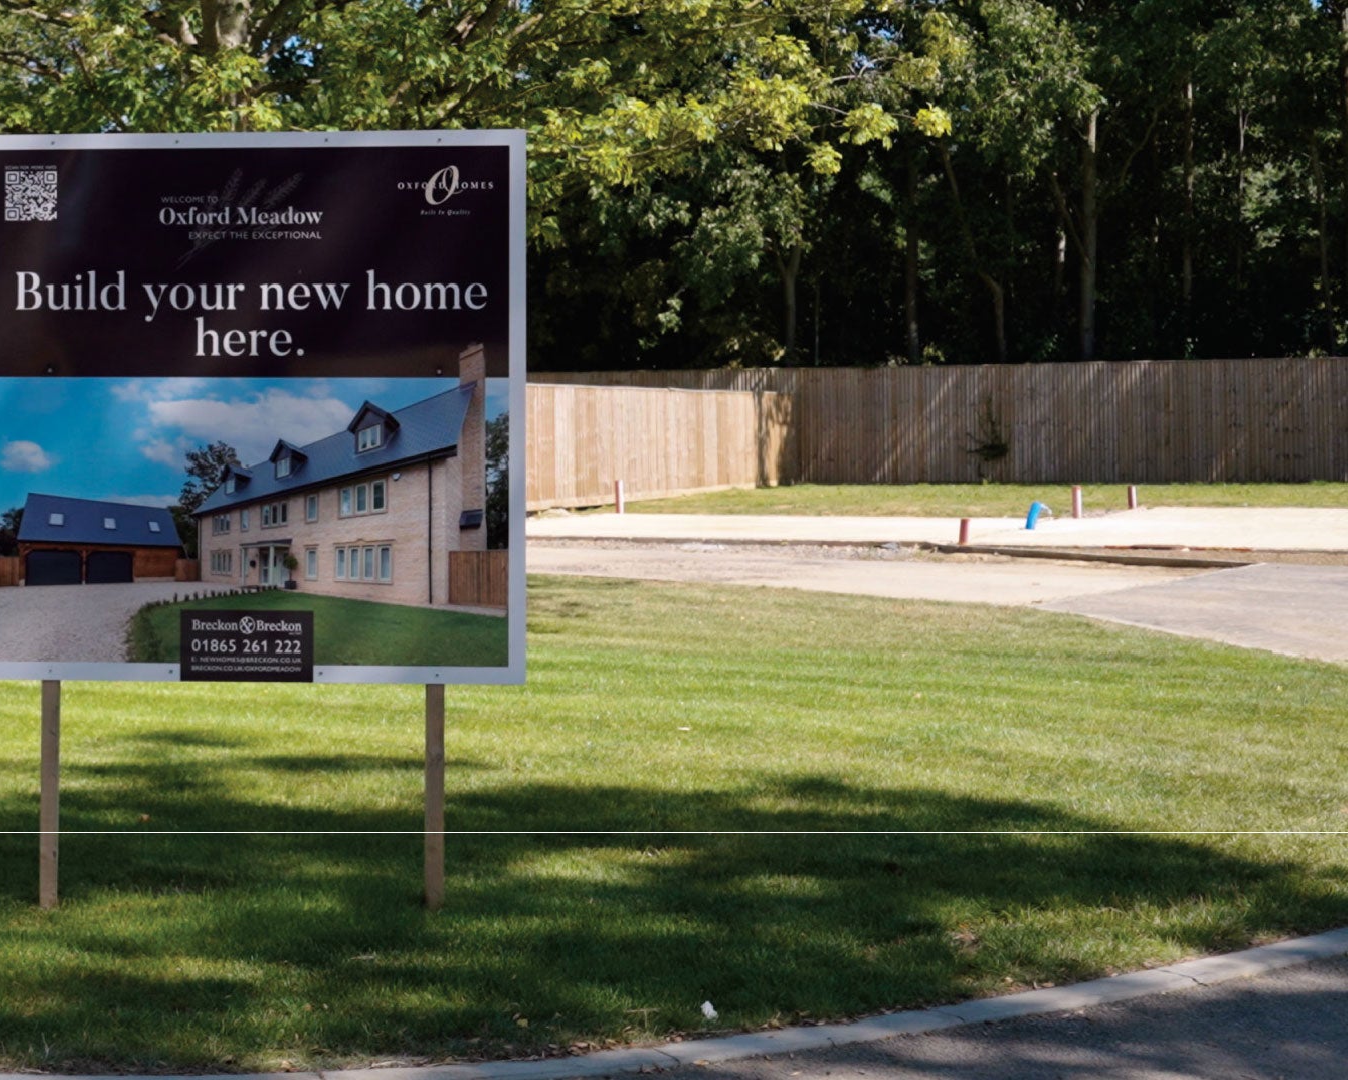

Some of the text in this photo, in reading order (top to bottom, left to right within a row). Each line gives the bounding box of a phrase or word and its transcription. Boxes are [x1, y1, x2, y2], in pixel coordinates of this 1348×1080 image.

[161, 195, 219, 204] WELCOME TO
[159, 206, 323, 225] Oxford Meadow
[188, 230, 322, 240] EXPECT THE EXCEPTIONAL
[15, 269, 488, 322] Build your new home
[195, 316, 305, 357] here.
[192, 616, 302, 634] Breckon & Breckon
[191, 638, 301, 654] 01865 261 222
